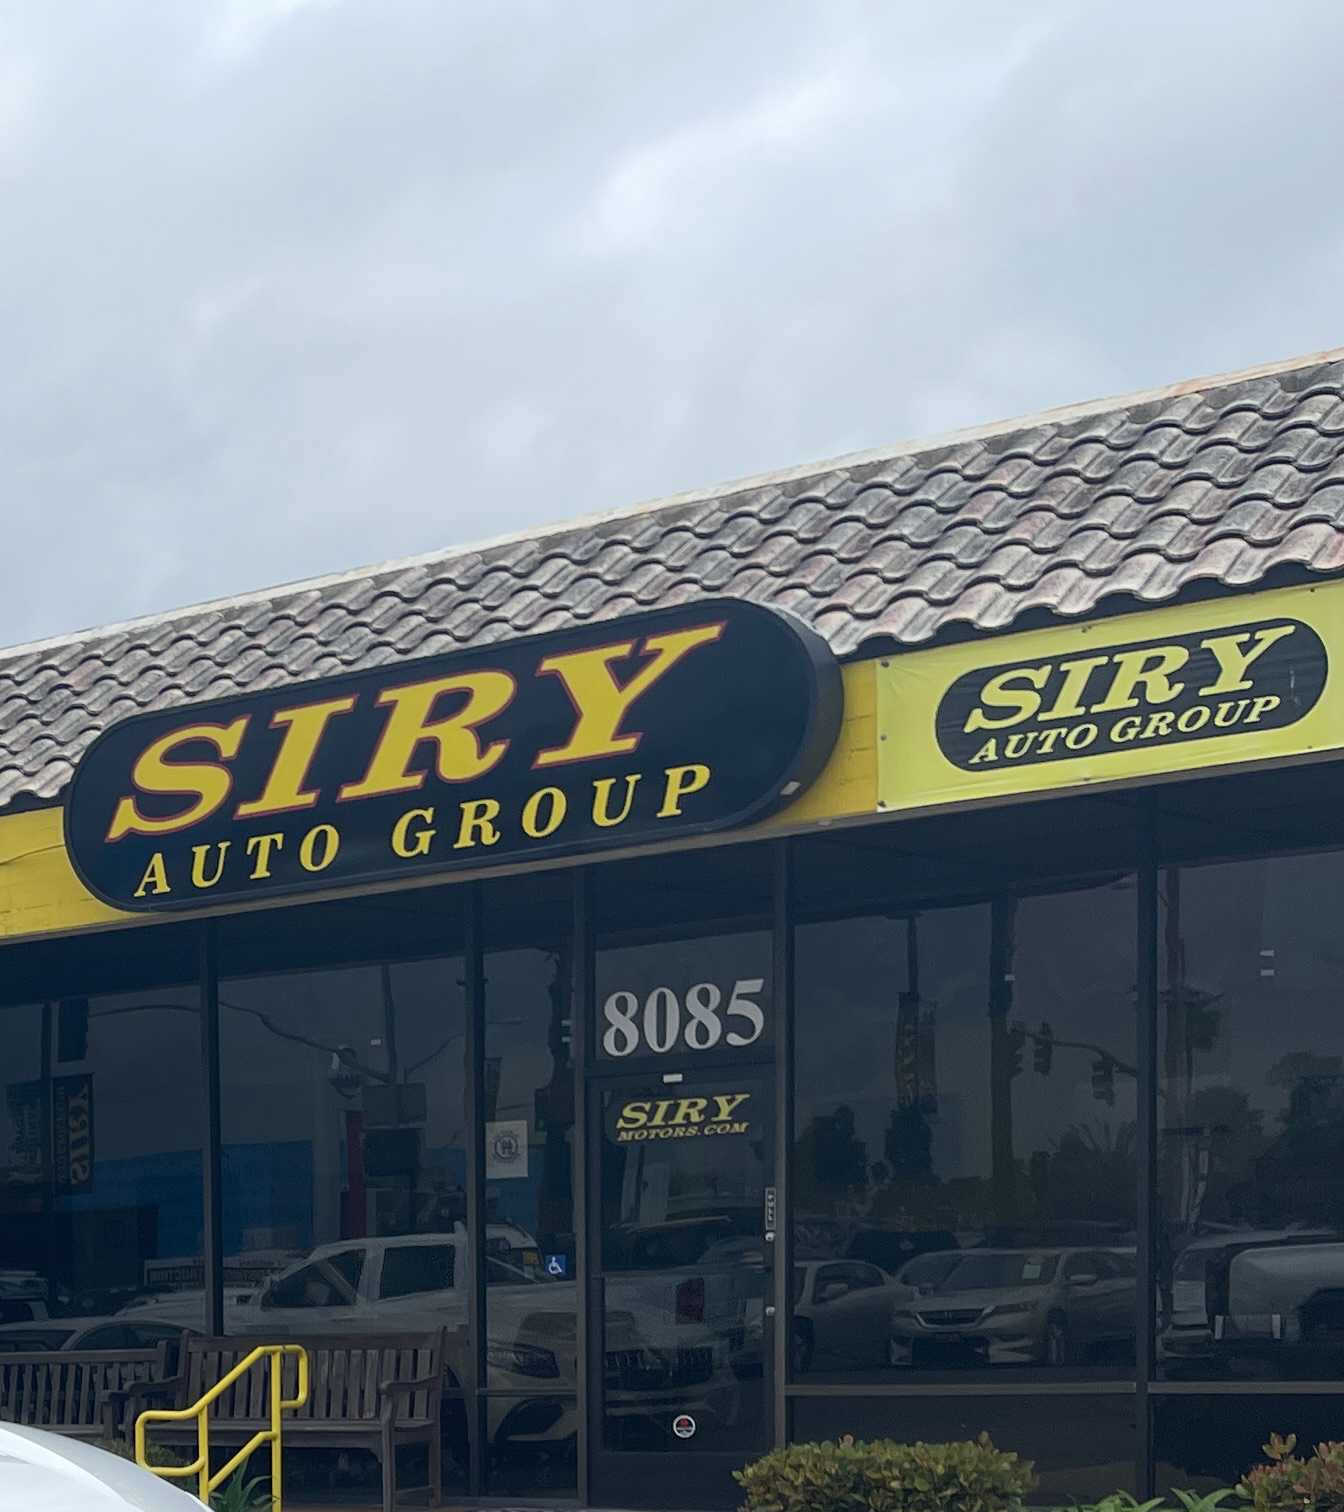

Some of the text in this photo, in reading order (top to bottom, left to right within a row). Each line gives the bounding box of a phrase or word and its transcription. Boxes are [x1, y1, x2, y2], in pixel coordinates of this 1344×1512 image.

[964, 625, 1295, 735] SIRY
[105, 620, 728, 842] SIRY
[969, 695, 1282, 764] AUTO GROUP
[133, 763, 712, 898] AUTO GROUP
[603, 978, 765, 1057] 8085
[616, 1094, 751, 1129] SIRY
